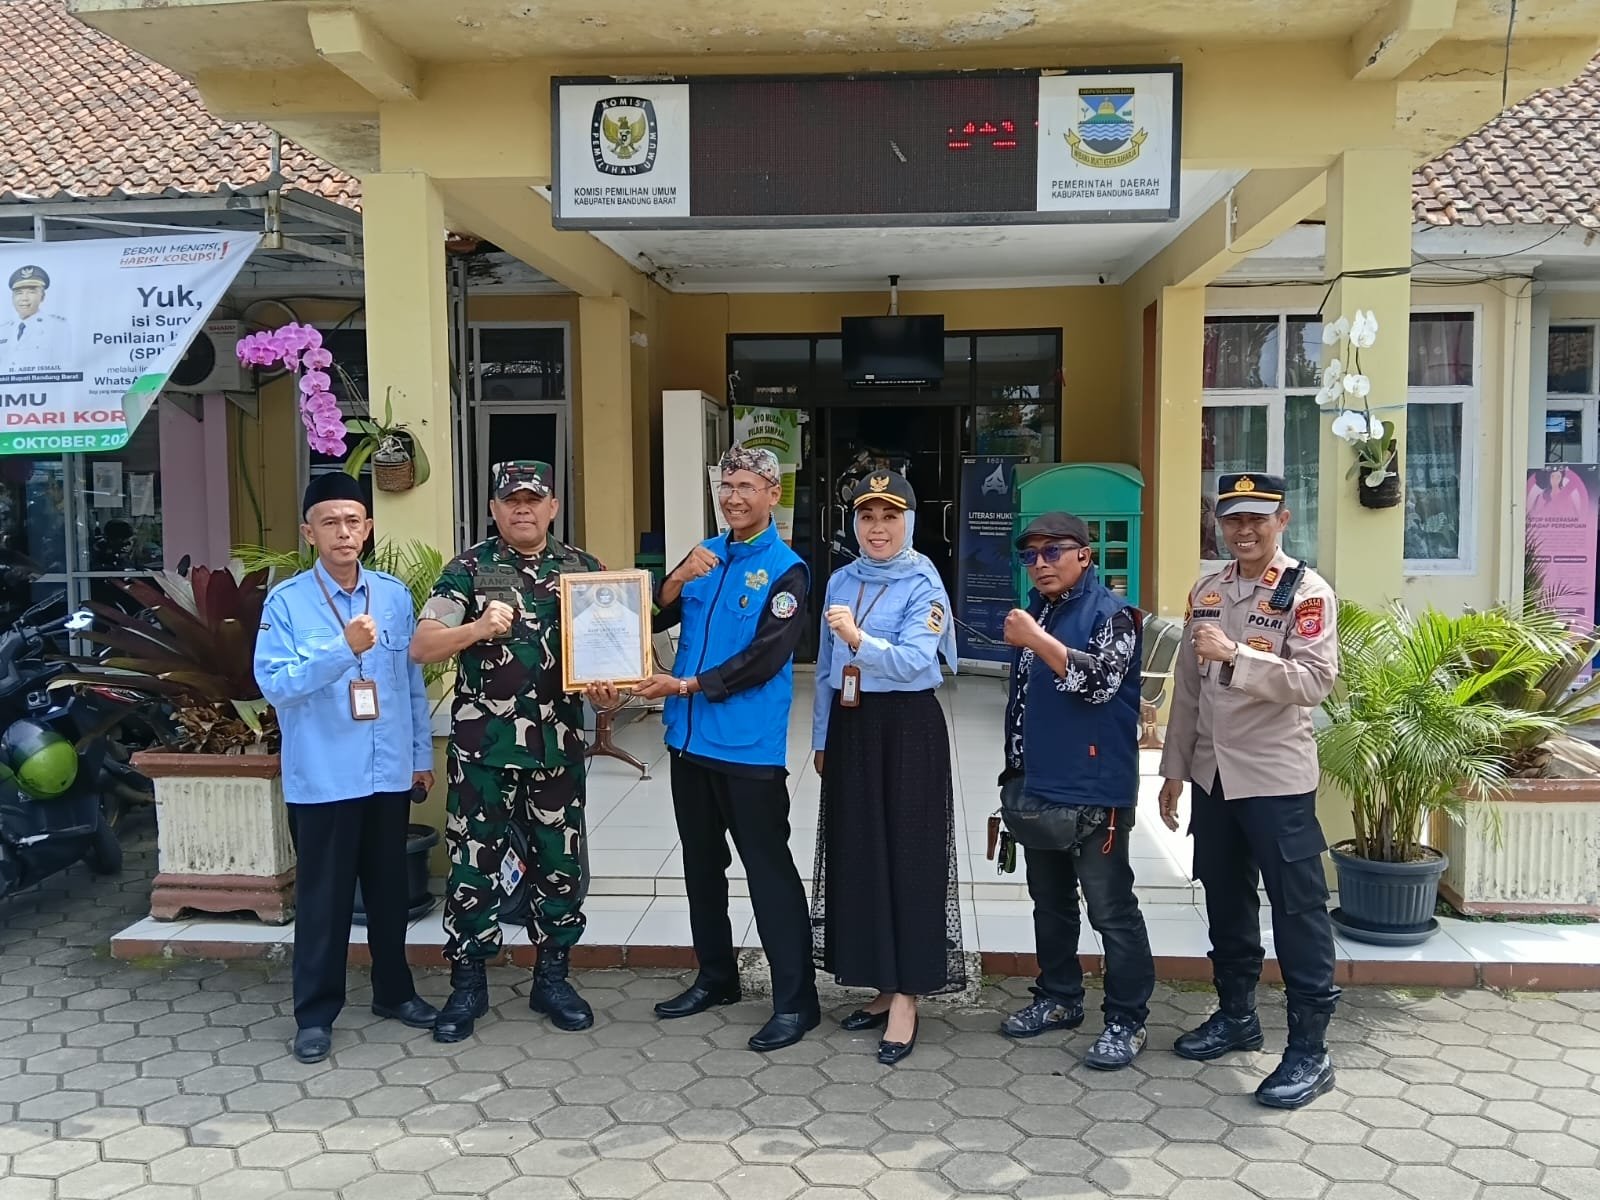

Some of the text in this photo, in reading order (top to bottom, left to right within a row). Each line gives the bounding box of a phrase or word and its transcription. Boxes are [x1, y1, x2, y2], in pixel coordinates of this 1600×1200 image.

[602, 98, 646, 109] KOMISI
[592, 132, 637, 174] PEMILIHAN
[644, 132, 657, 168] UMUM
[1052, 178, 1160, 190] PEMERINTAH DAERAH
[574, 186, 676, 196] KOMISI PEMILIHAN UMUM
[1052, 188, 1160, 198] KABUPATEN BANDUNG BARAT
[654, 197, 676, 205] BARAT
[123, 246, 166, 256] BERANI
[120, 256, 158, 265] HABISI
[163, 253, 217, 262] KORUPSI
[138, 284, 202, 310] Yuk,
[132, 315, 150, 327] isi
[94, 332, 165, 344] Penilaian
[6, 412, 66, 426] DARI
[12, 436, 96, 450] OKTOBER
[1248, 614, 1284, 630] POLRI
